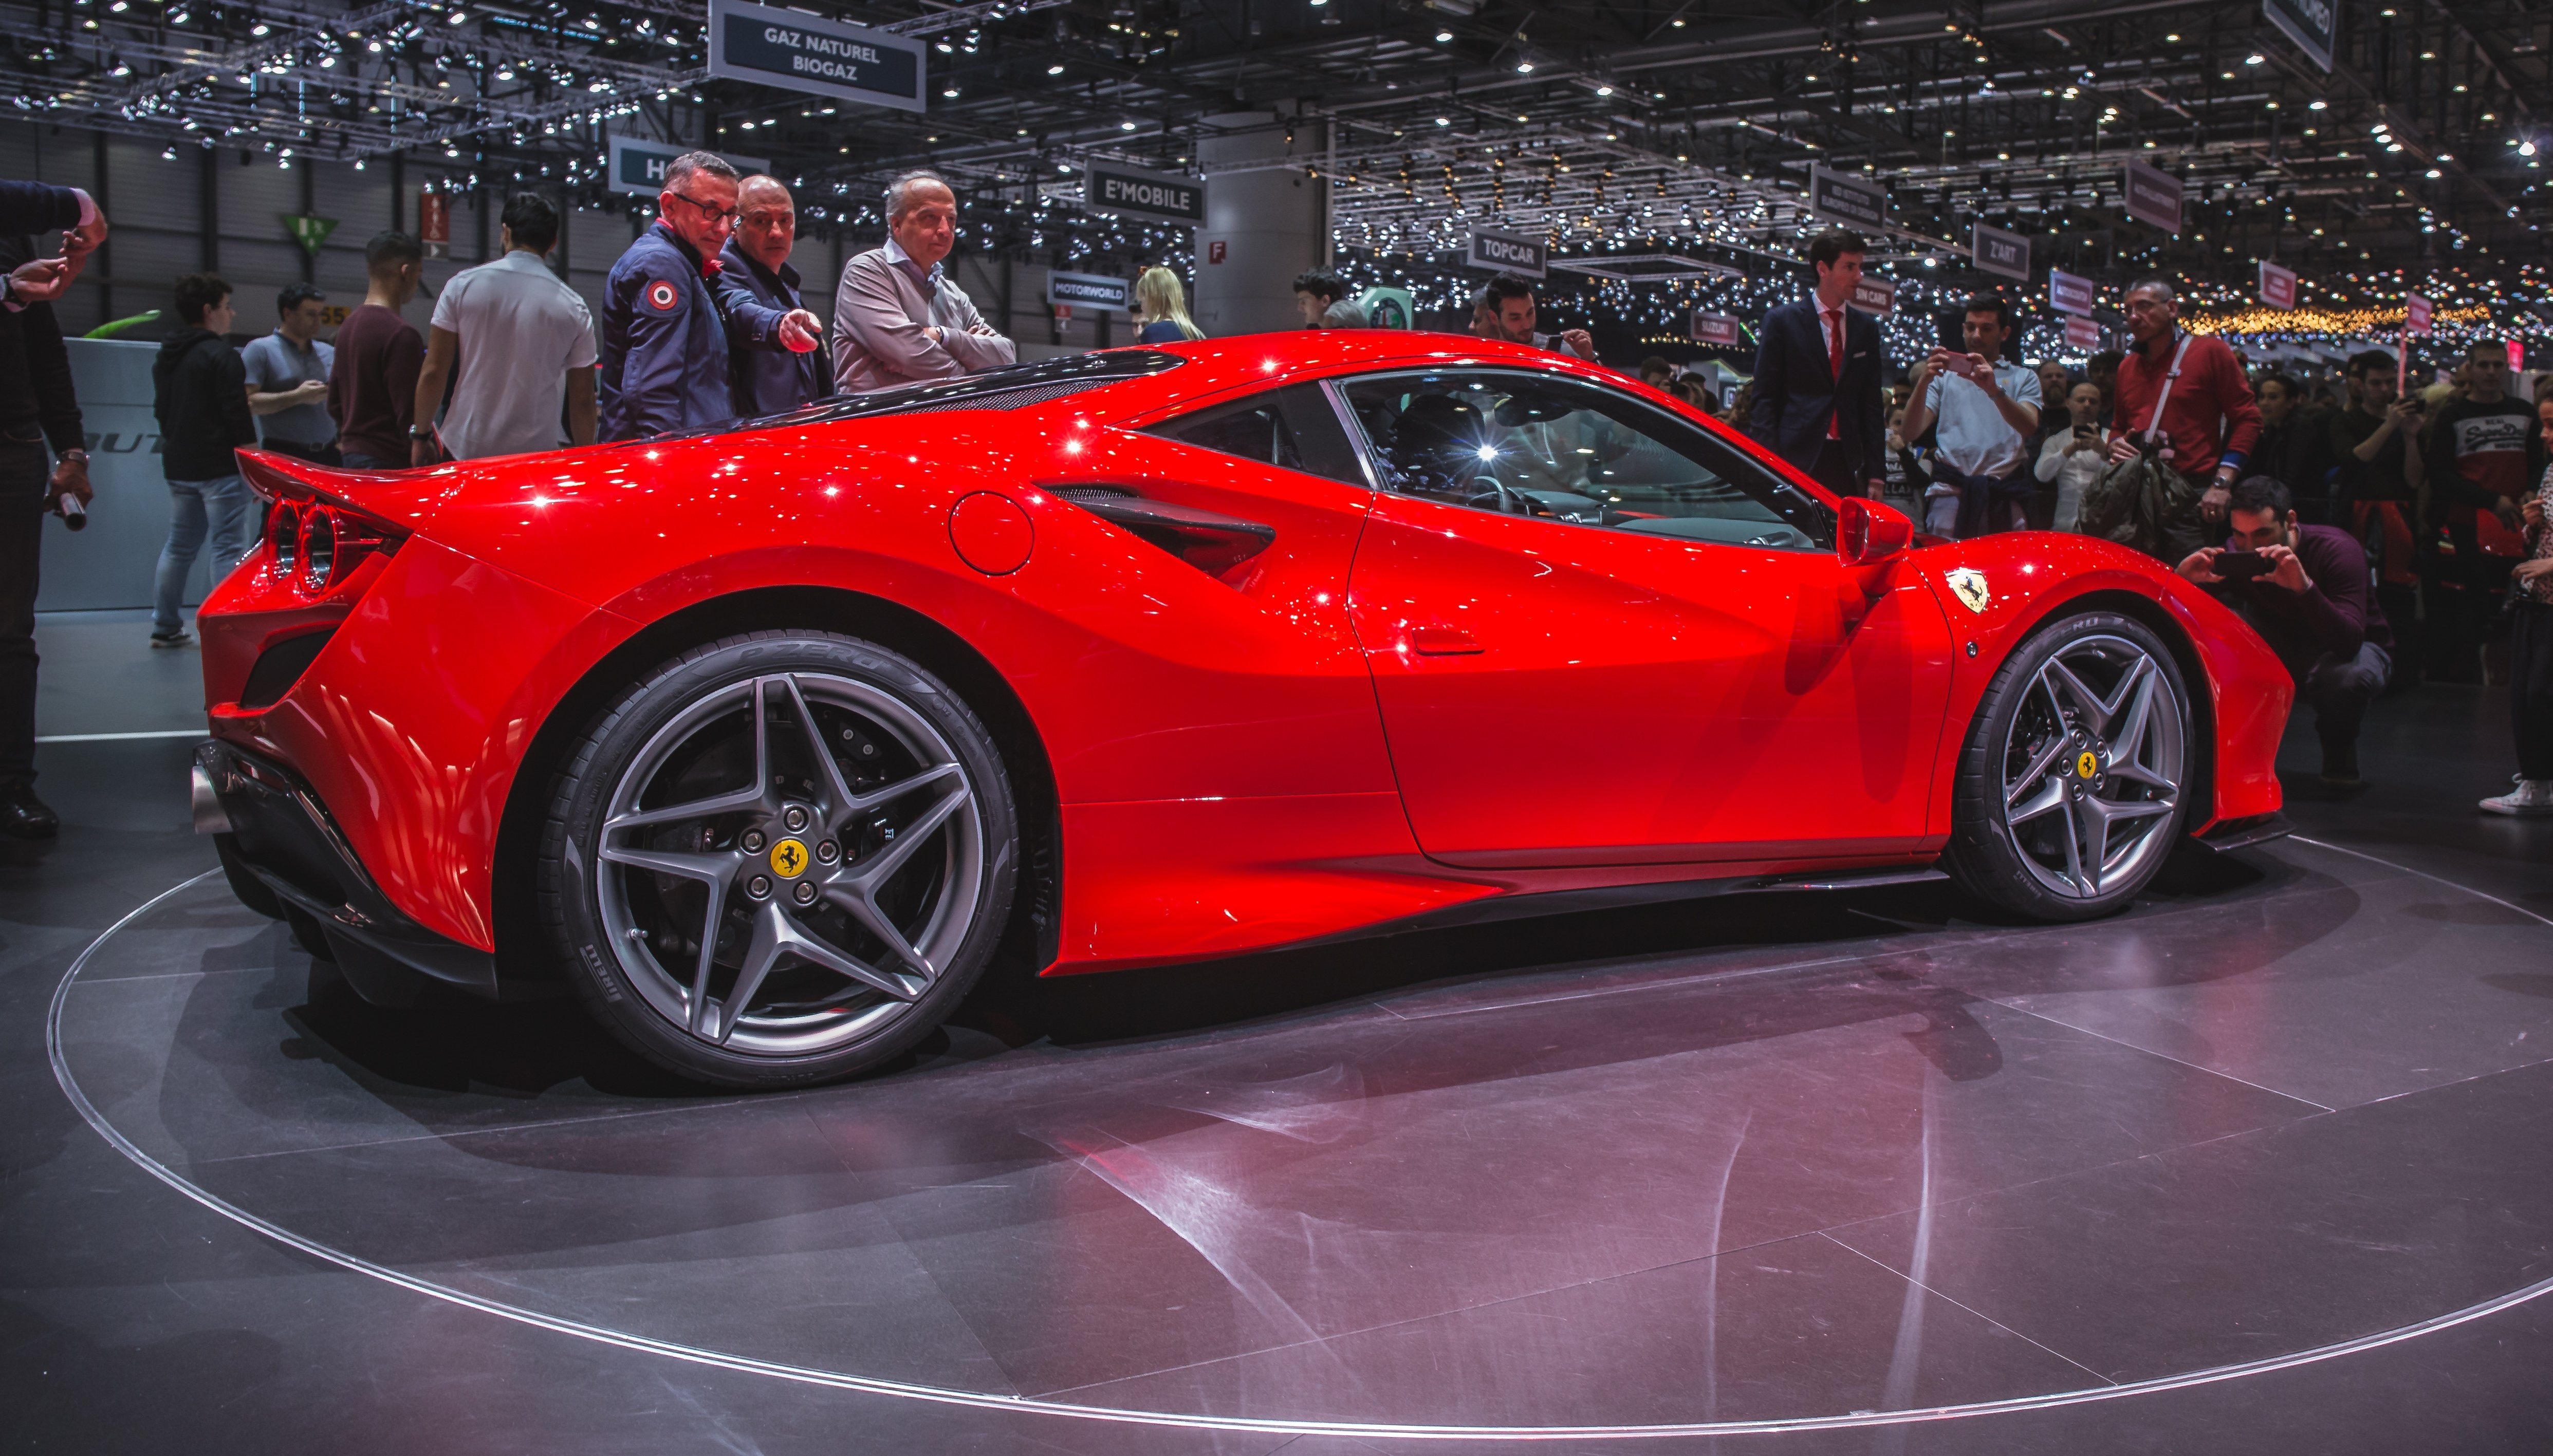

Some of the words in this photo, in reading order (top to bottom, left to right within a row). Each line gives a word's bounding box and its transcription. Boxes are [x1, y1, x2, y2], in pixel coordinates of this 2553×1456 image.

[765, 28, 801, 48] GAZ
[806, 35, 880, 64] NATUREL
[793, 55, 857, 81] BIOGAZ
[1105, 179, 1190, 210] E'MOBILE
[1483, 238, 1534, 264] TOPCAR
[1056, 283, 1123, 300] MOTORWORLD
[772, 643, 881, 669] ZERO
[579, 944, 623, 1003] PIRELLI
